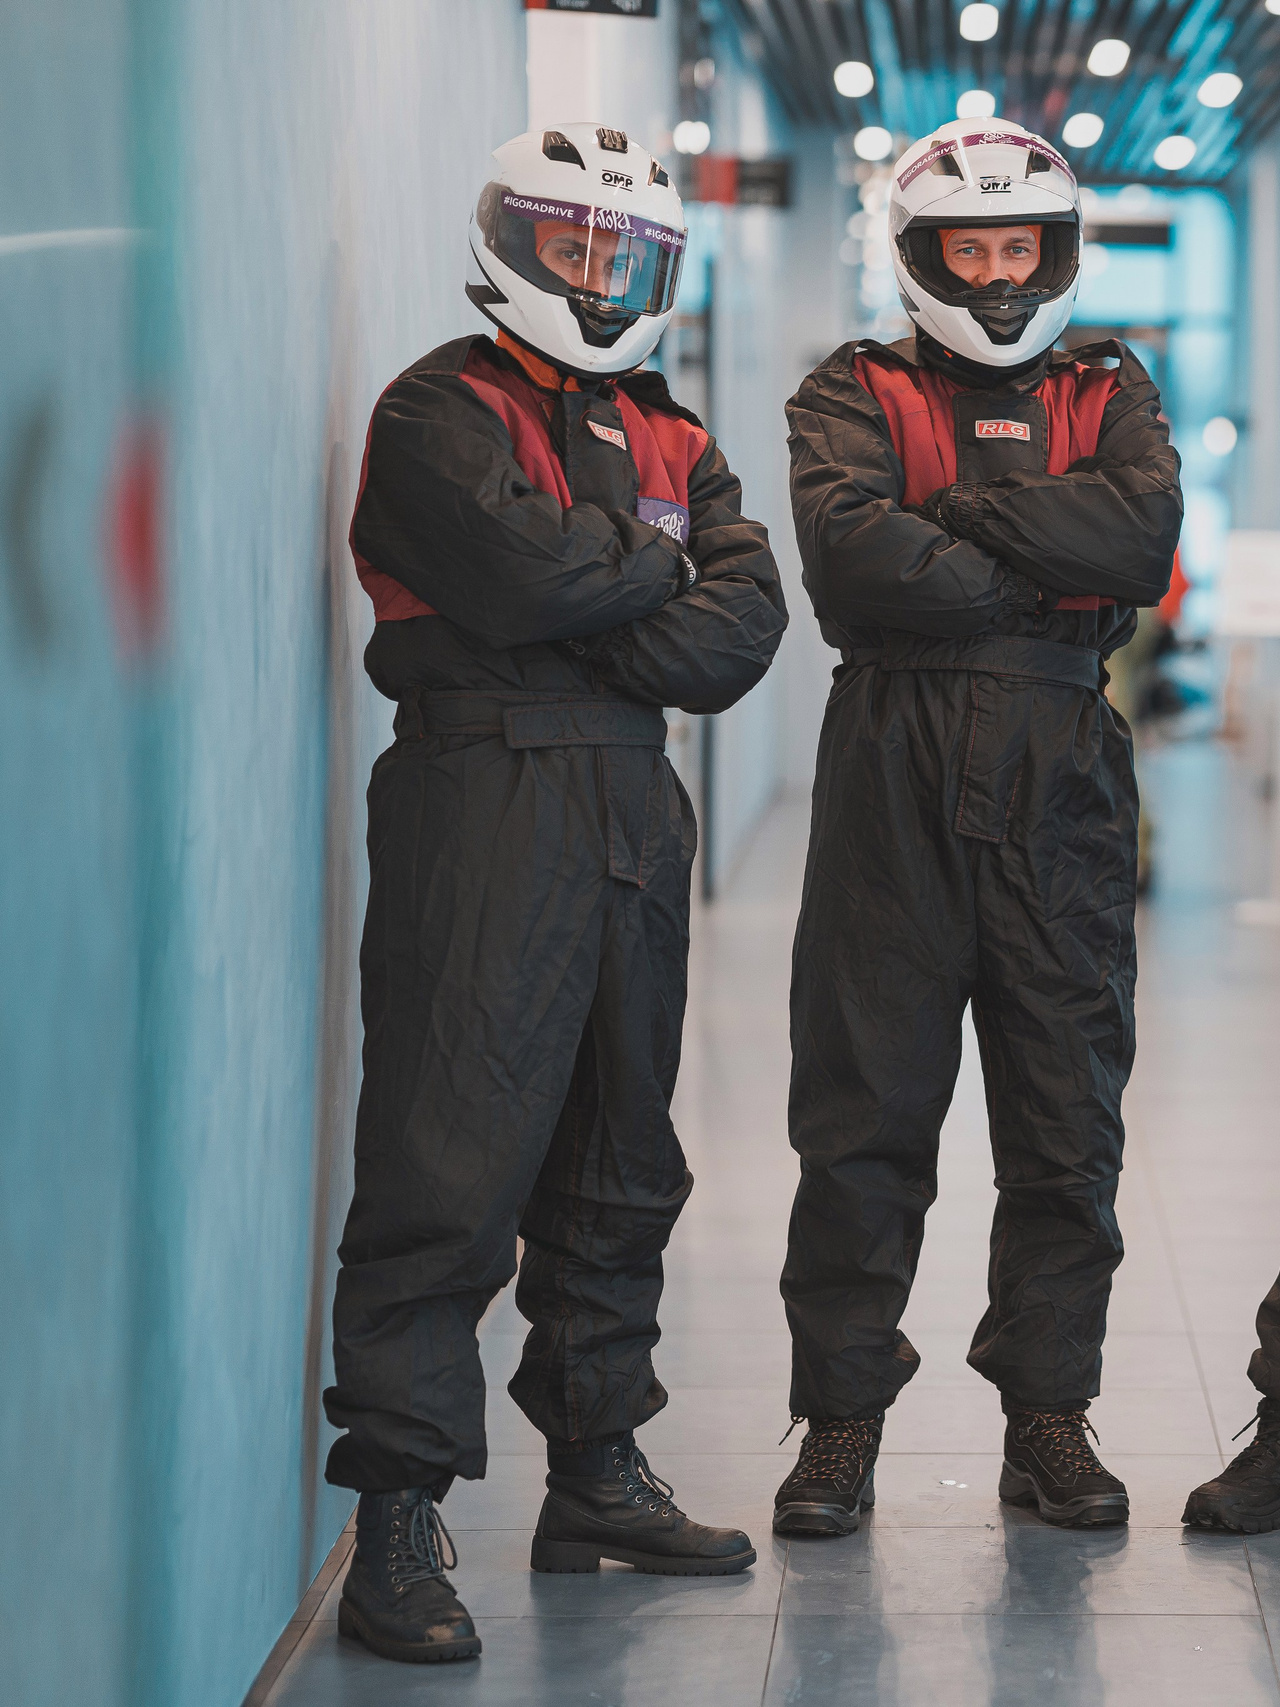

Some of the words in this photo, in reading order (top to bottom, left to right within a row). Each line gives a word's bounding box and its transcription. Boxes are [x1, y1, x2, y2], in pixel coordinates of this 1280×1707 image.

[602, 173, 633, 187] OMP
[503, 195, 575, 219] #IGORADRIVE
[644, 227, 685, 248] #IGORADR
[594, 427, 622, 443] RLG
[982, 423, 1024, 435] RLG
